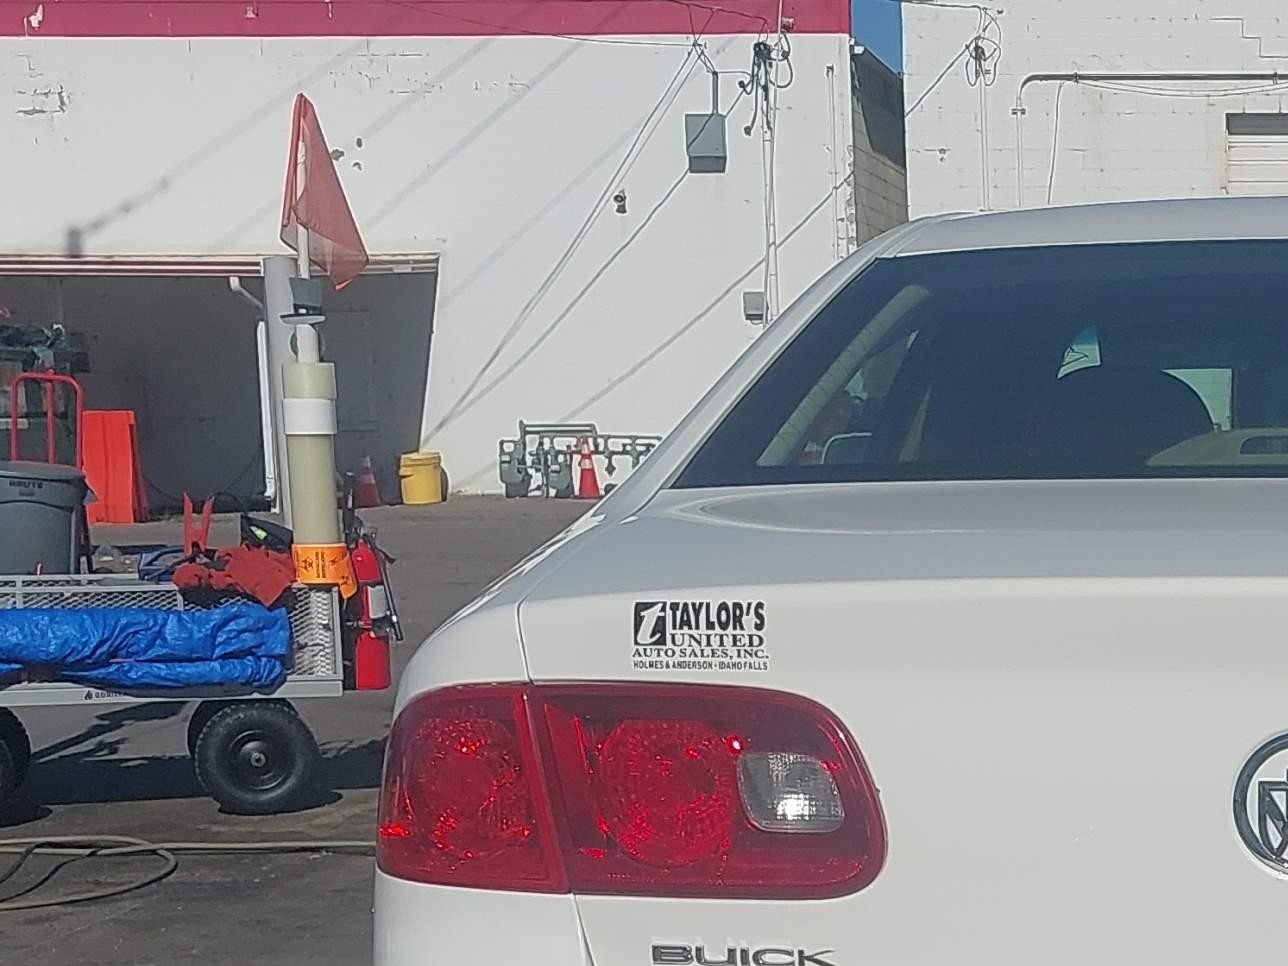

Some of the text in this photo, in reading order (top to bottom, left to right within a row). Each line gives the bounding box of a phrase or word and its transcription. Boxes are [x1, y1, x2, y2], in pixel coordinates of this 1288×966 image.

[669, 601, 766, 632] TAYLOR'S
[668, 633, 765, 648] UNITED
[632, 647, 770, 660] AUTO SALES, INC.
[671, 660, 713, 670] ANDERSON
[743, 660, 768, 671] FALLS
